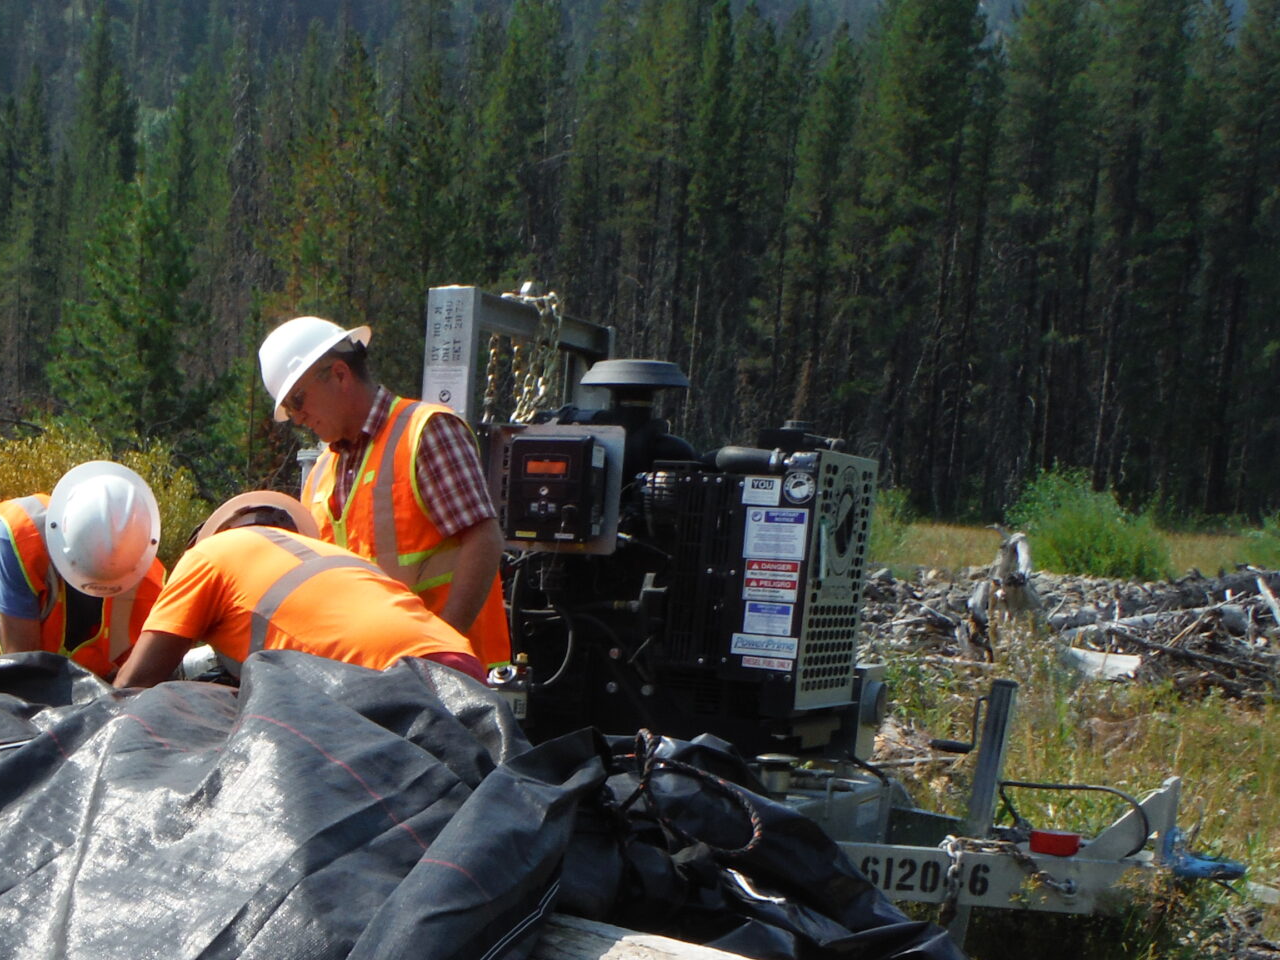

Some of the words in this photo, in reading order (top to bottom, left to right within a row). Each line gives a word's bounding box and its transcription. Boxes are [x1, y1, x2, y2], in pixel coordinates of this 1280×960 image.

[753, 480, 773, 489] YOU
[761, 562, 792, 571] DANGER
[759, 579, 791, 588] PELIGRO
[734, 636, 795, 650] PowerPrime
